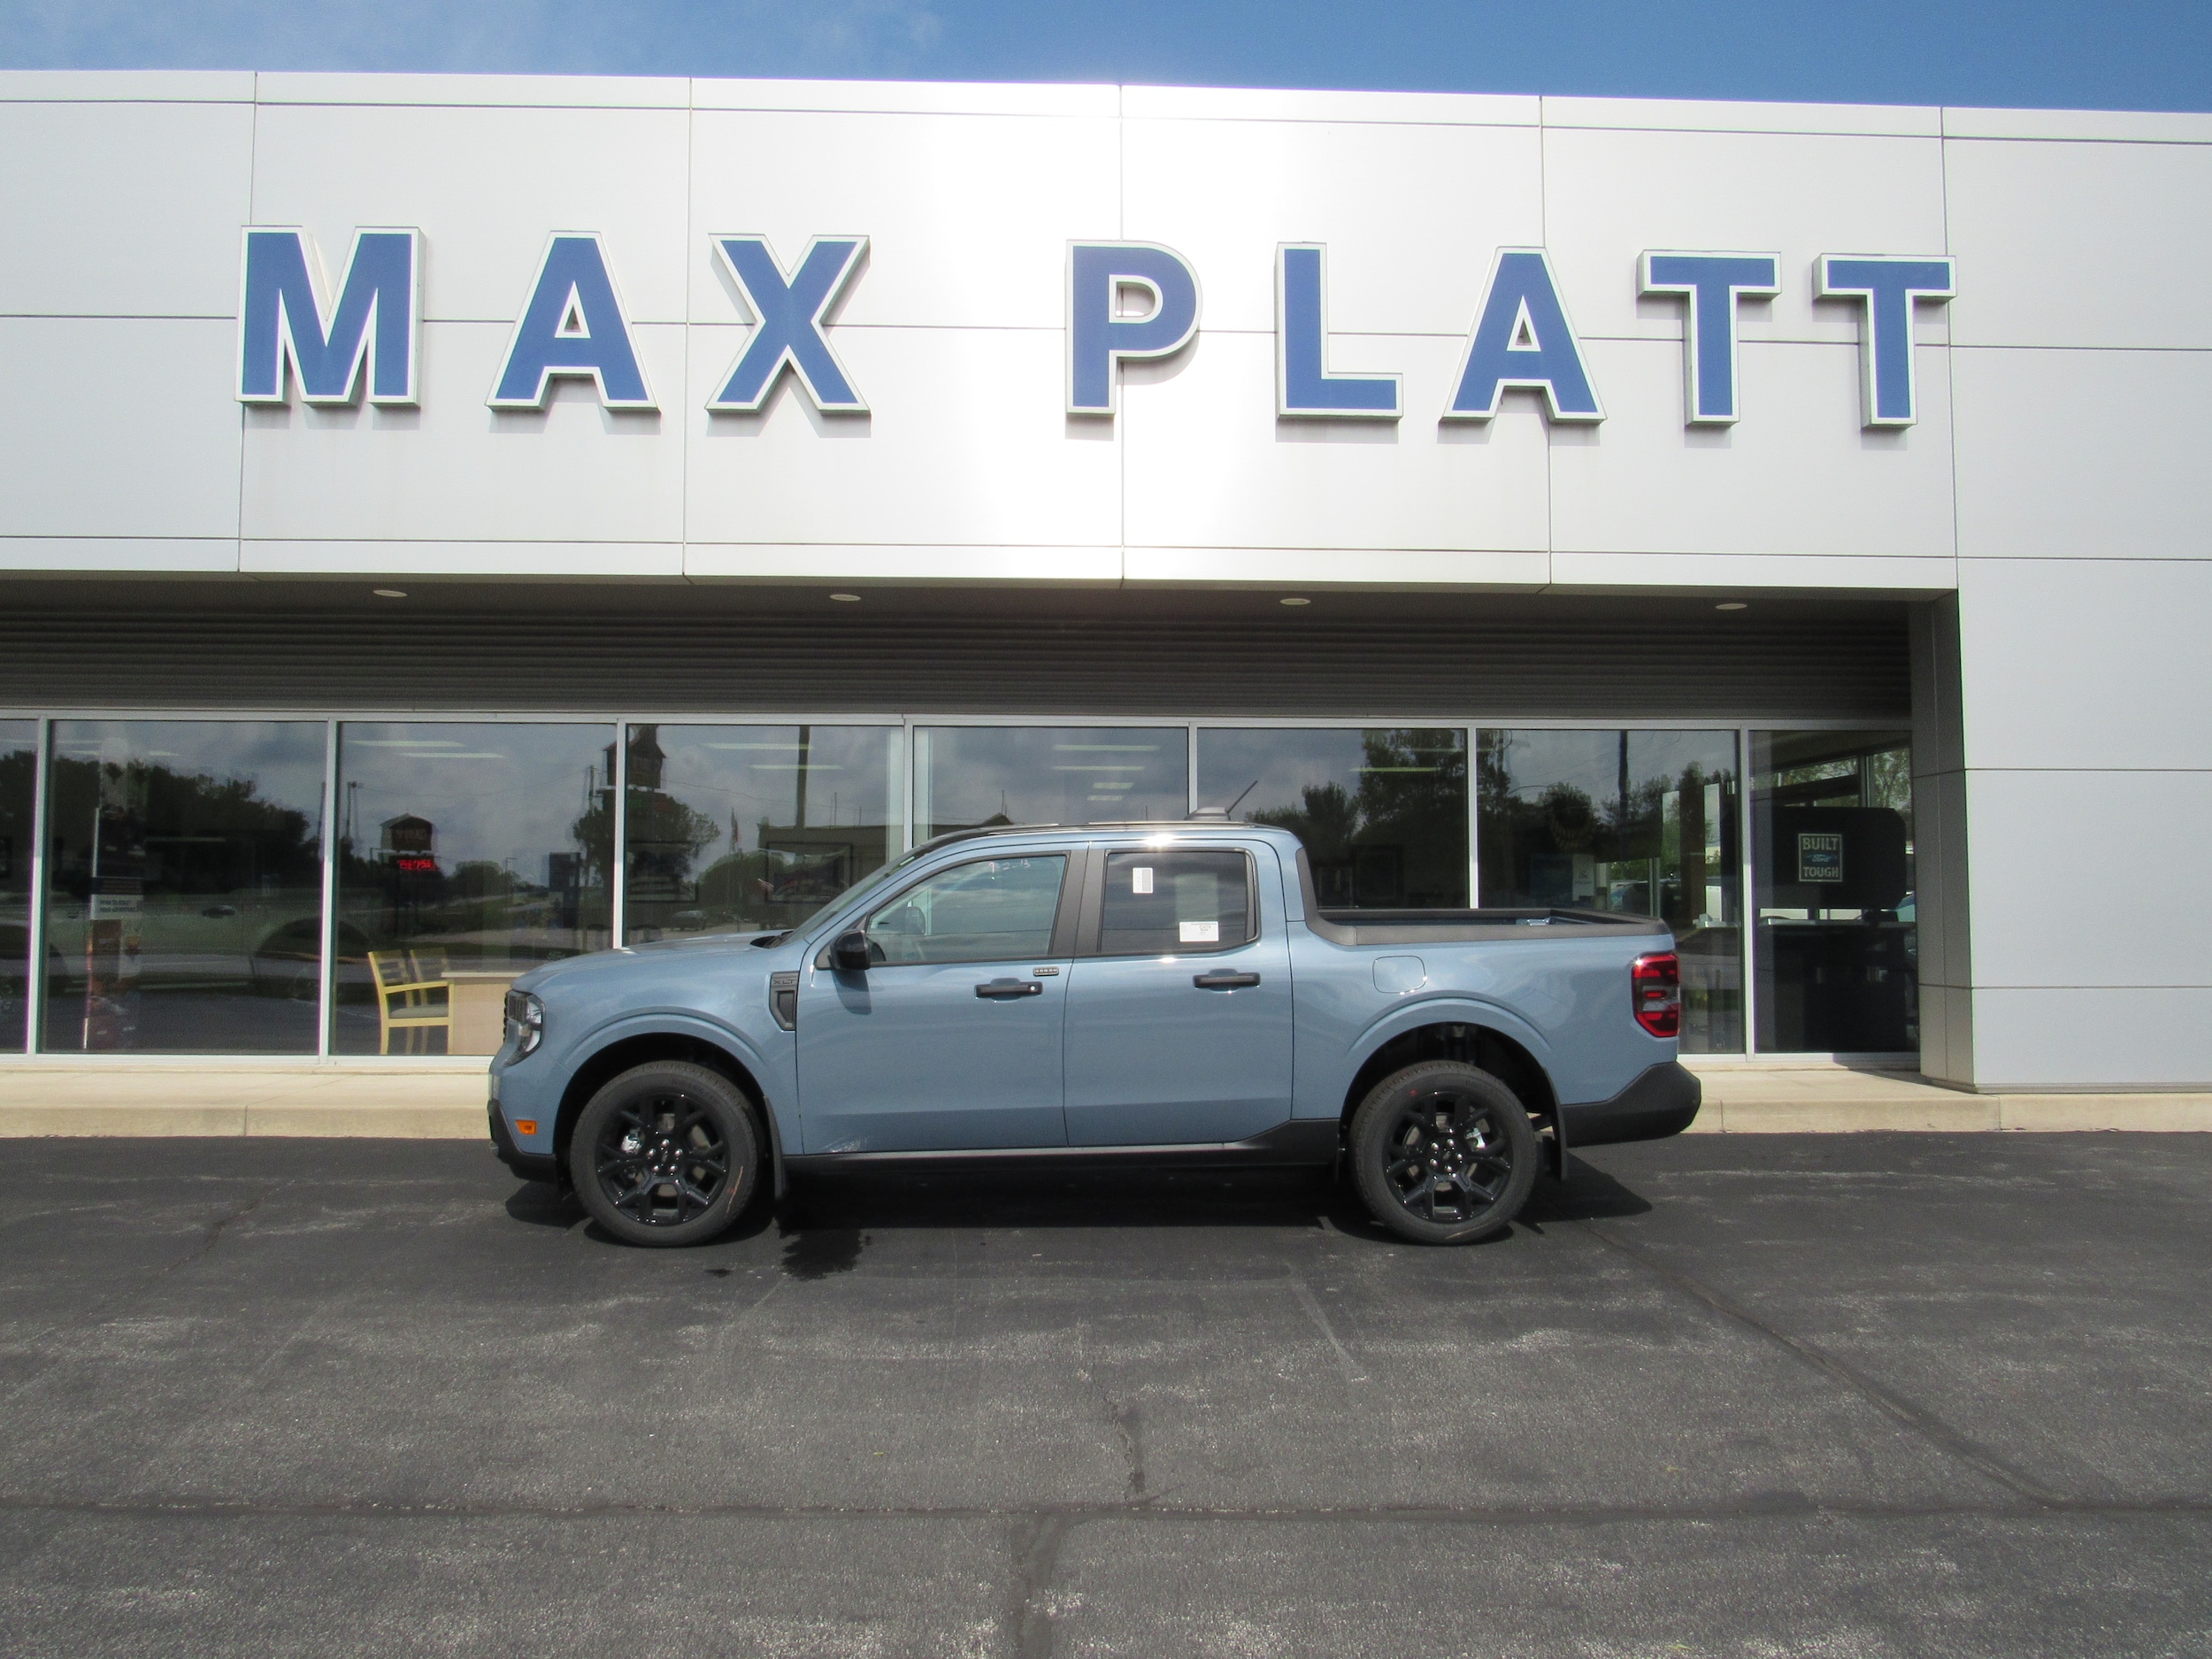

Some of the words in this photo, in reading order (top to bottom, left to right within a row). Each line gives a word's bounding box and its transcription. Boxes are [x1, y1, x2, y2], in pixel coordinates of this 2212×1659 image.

[234, 226, 871, 413] MAX
[1064, 239, 1957, 429] PLATT
[1802, 837, 1839, 850] BUILT
[1803, 866, 1839, 878] TOUGH
